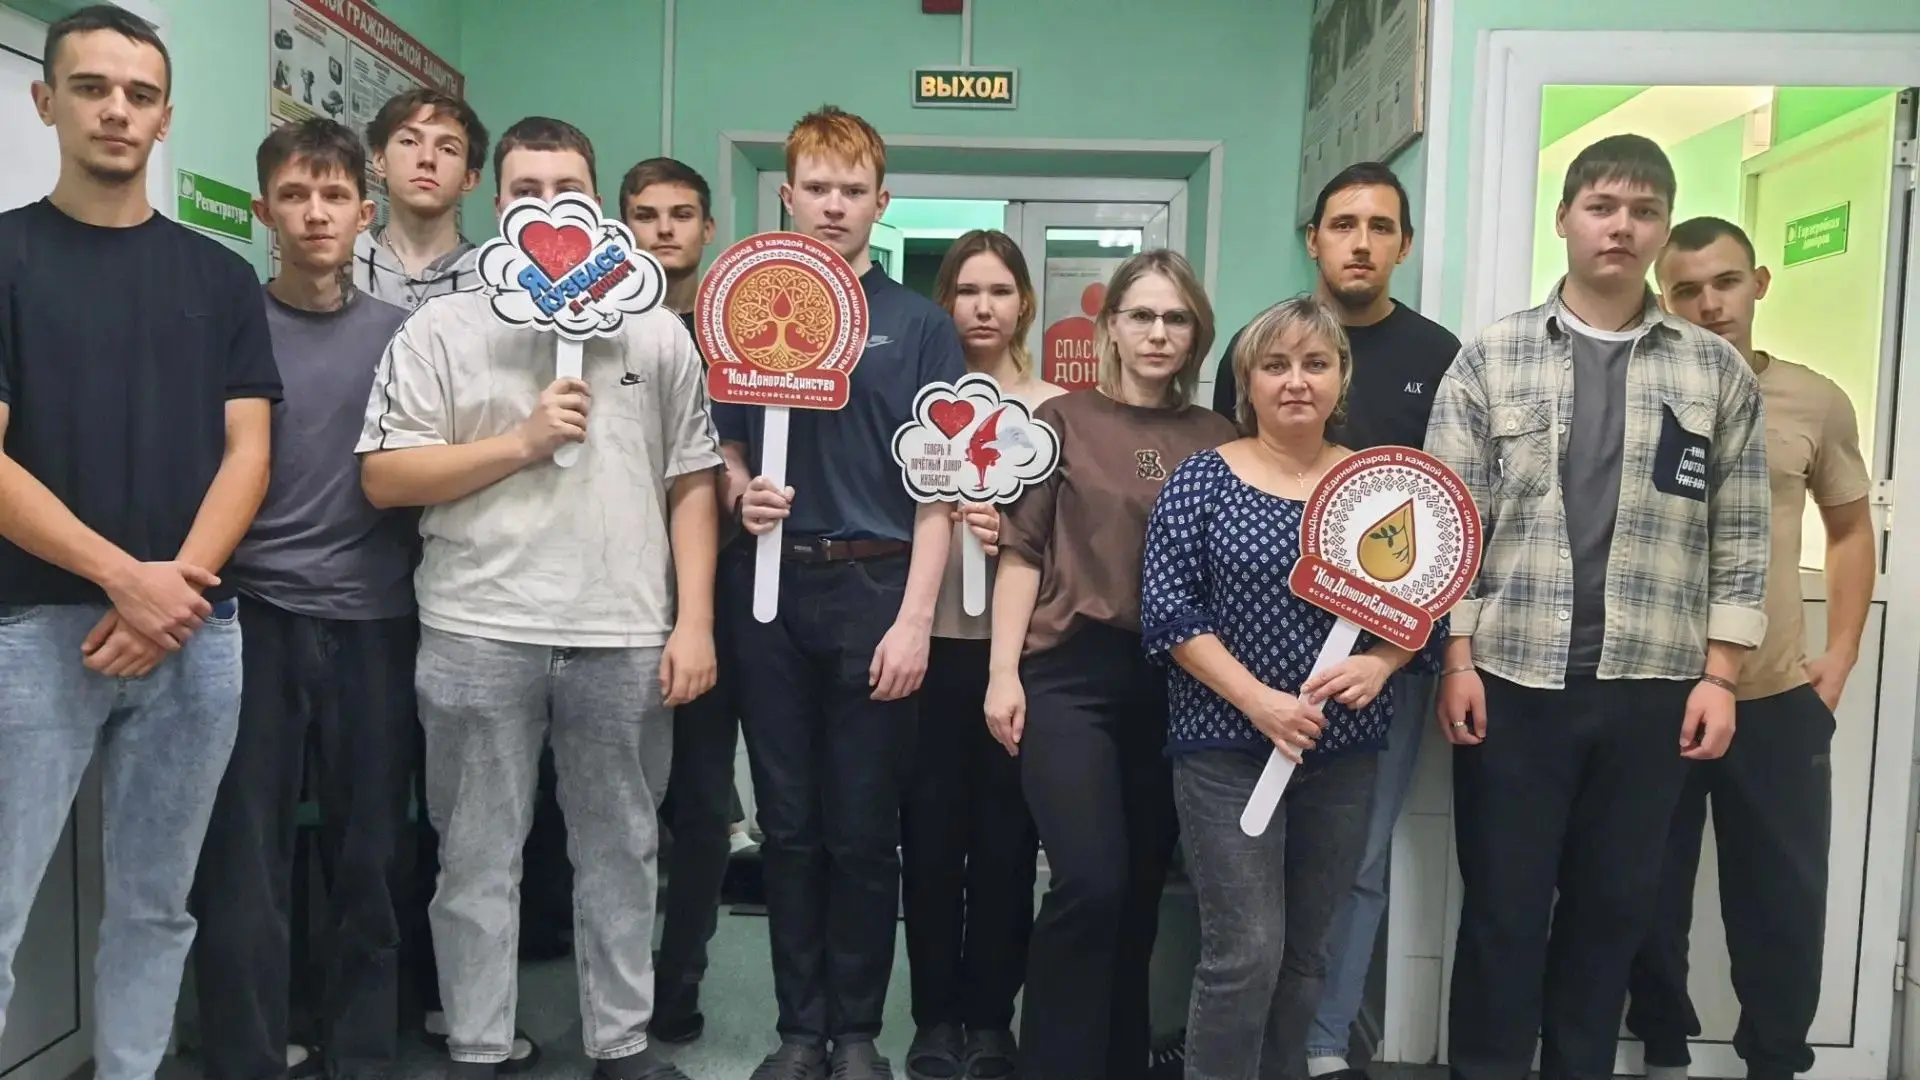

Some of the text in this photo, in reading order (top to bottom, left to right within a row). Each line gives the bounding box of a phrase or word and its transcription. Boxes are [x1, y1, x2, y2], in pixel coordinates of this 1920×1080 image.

[347, 2, 421, 69] ГРАЖДАНСКОЙ
[920, 76, 1009, 100] ВЫХОД
[755, 240, 764, 249] В
[765, 239, 804, 250] каждой
[805, 244, 832, 262] капле
[517, 264, 553, 302] Я
[535, 244, 626, 318] КУЗБАСС
[835, 267, 852, 289] сила
[850, 287, 861, 327] нашего
[838, 327, 861, 369] единства
[727, 388, 801, 400] ВСЕРОССИЙСКАЯ
[924, 443, 944, 456] ТЕПЕРЬ
[1395, 453, 1403, 461] В
[943, 460, 961, 472] ДОНОР
[1405, 456, 1442, 477] каждой
[1442, 475, 1464, 501] капле
[1308, 454, 1391, 553] #КодДонораЕдиныйНарод
[1464, 510, 1474, 534] сила
[1461, 537, 1475, 575] нашего
[1428, 576, 1464, 612] единства
[1309, 587, 1410, 641] ВСЕРОССИЙСКАЯ АКЦИЯ
